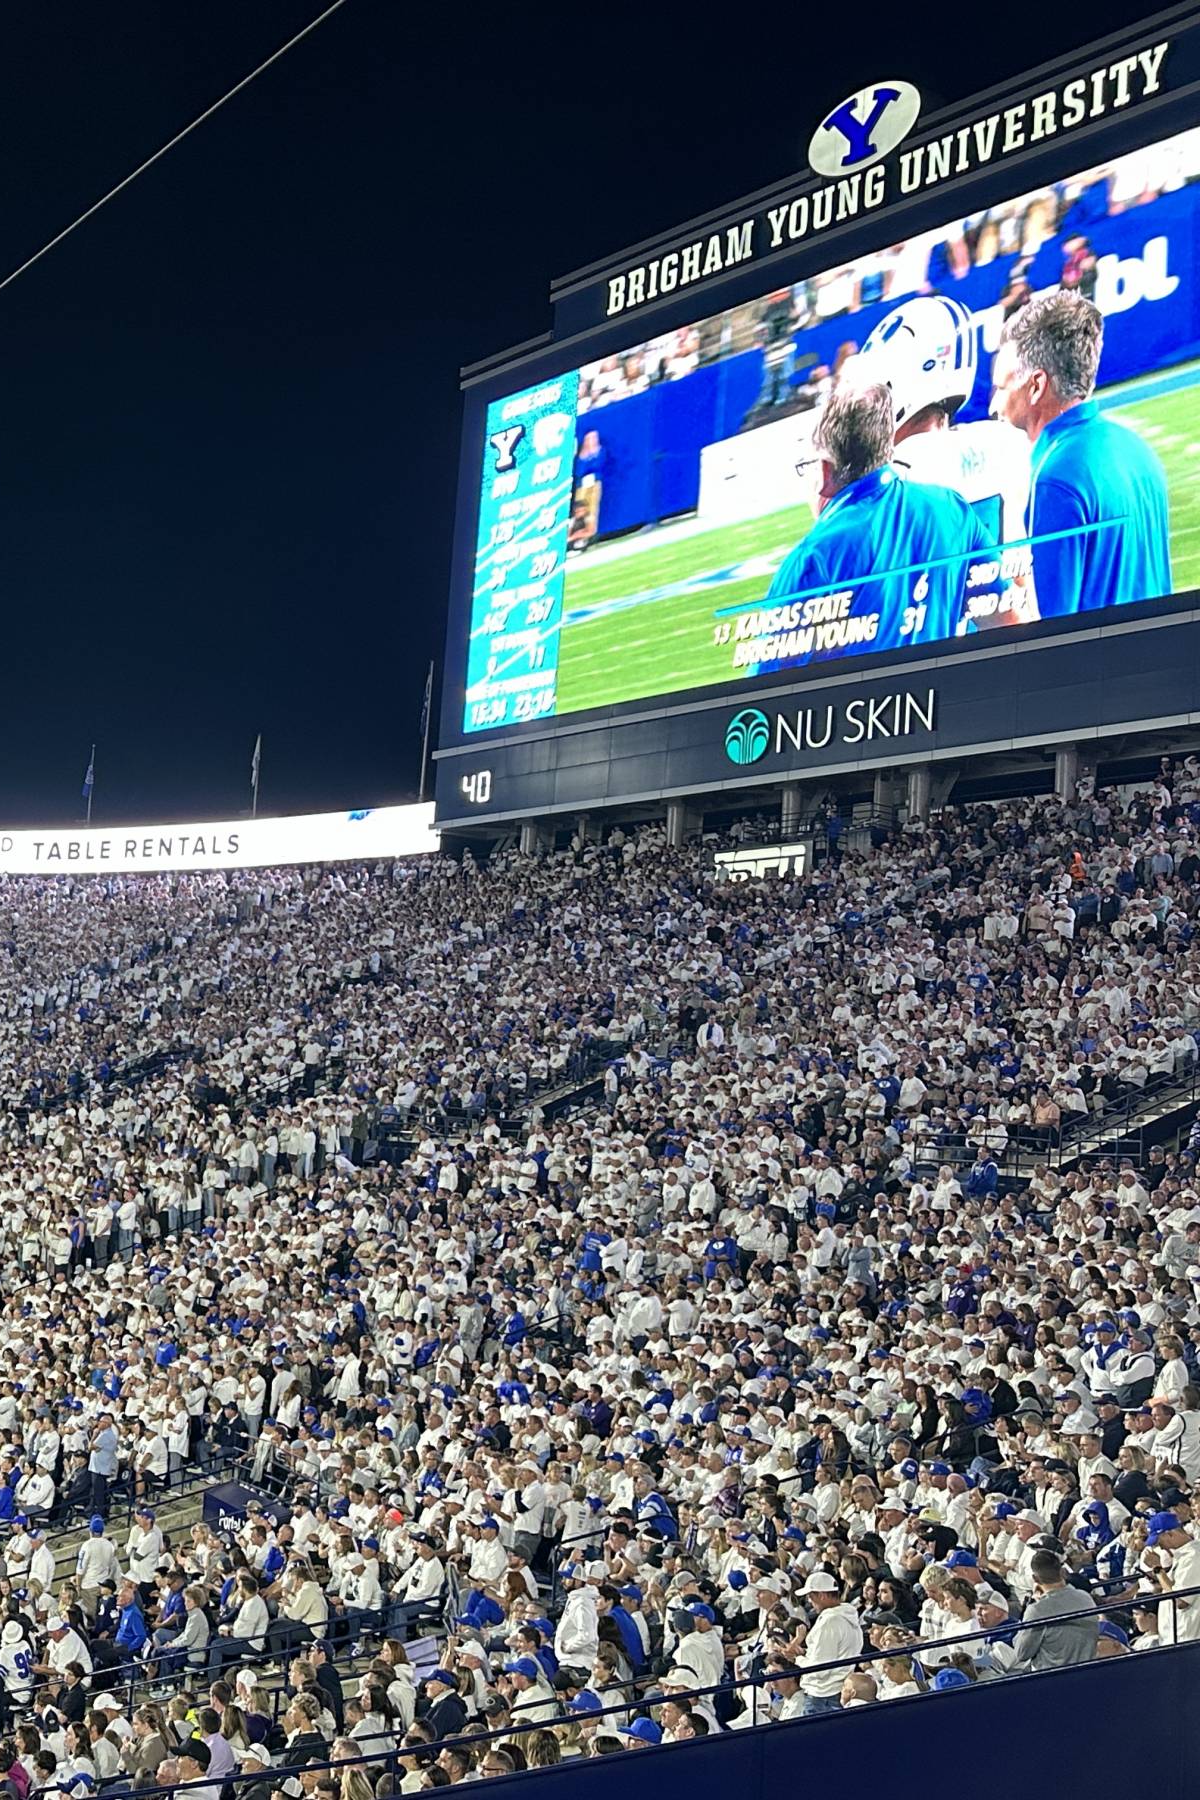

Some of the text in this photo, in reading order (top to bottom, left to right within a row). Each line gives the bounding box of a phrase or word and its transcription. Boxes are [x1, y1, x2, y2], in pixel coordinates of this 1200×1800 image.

[822, 86, 902, 168] Y
[605, 42, 1169, 317] BRIGHAM YOUNG UNIVERSITY
[490, 424, 526, 473] Y
[713, 625, 731, 646] 13
[735, 602, 802, 642] KANSAS
[801, 591, 853, 625] STATE
[914, 572, 929, 602] 6
[966, 561, 999, 588] 3RD
[732, 621, 815, 668] BRIGHAM
[813, 612, 880, 651] YOUNG
[899, 602, 928, 636] 31
[965, 592, 999, 619] 3RD
[775, 688, 935, 754] NU SKIN
[462, 769, 492, 804] 40
[33, 834, 240, 861] TABLE RENTALS
